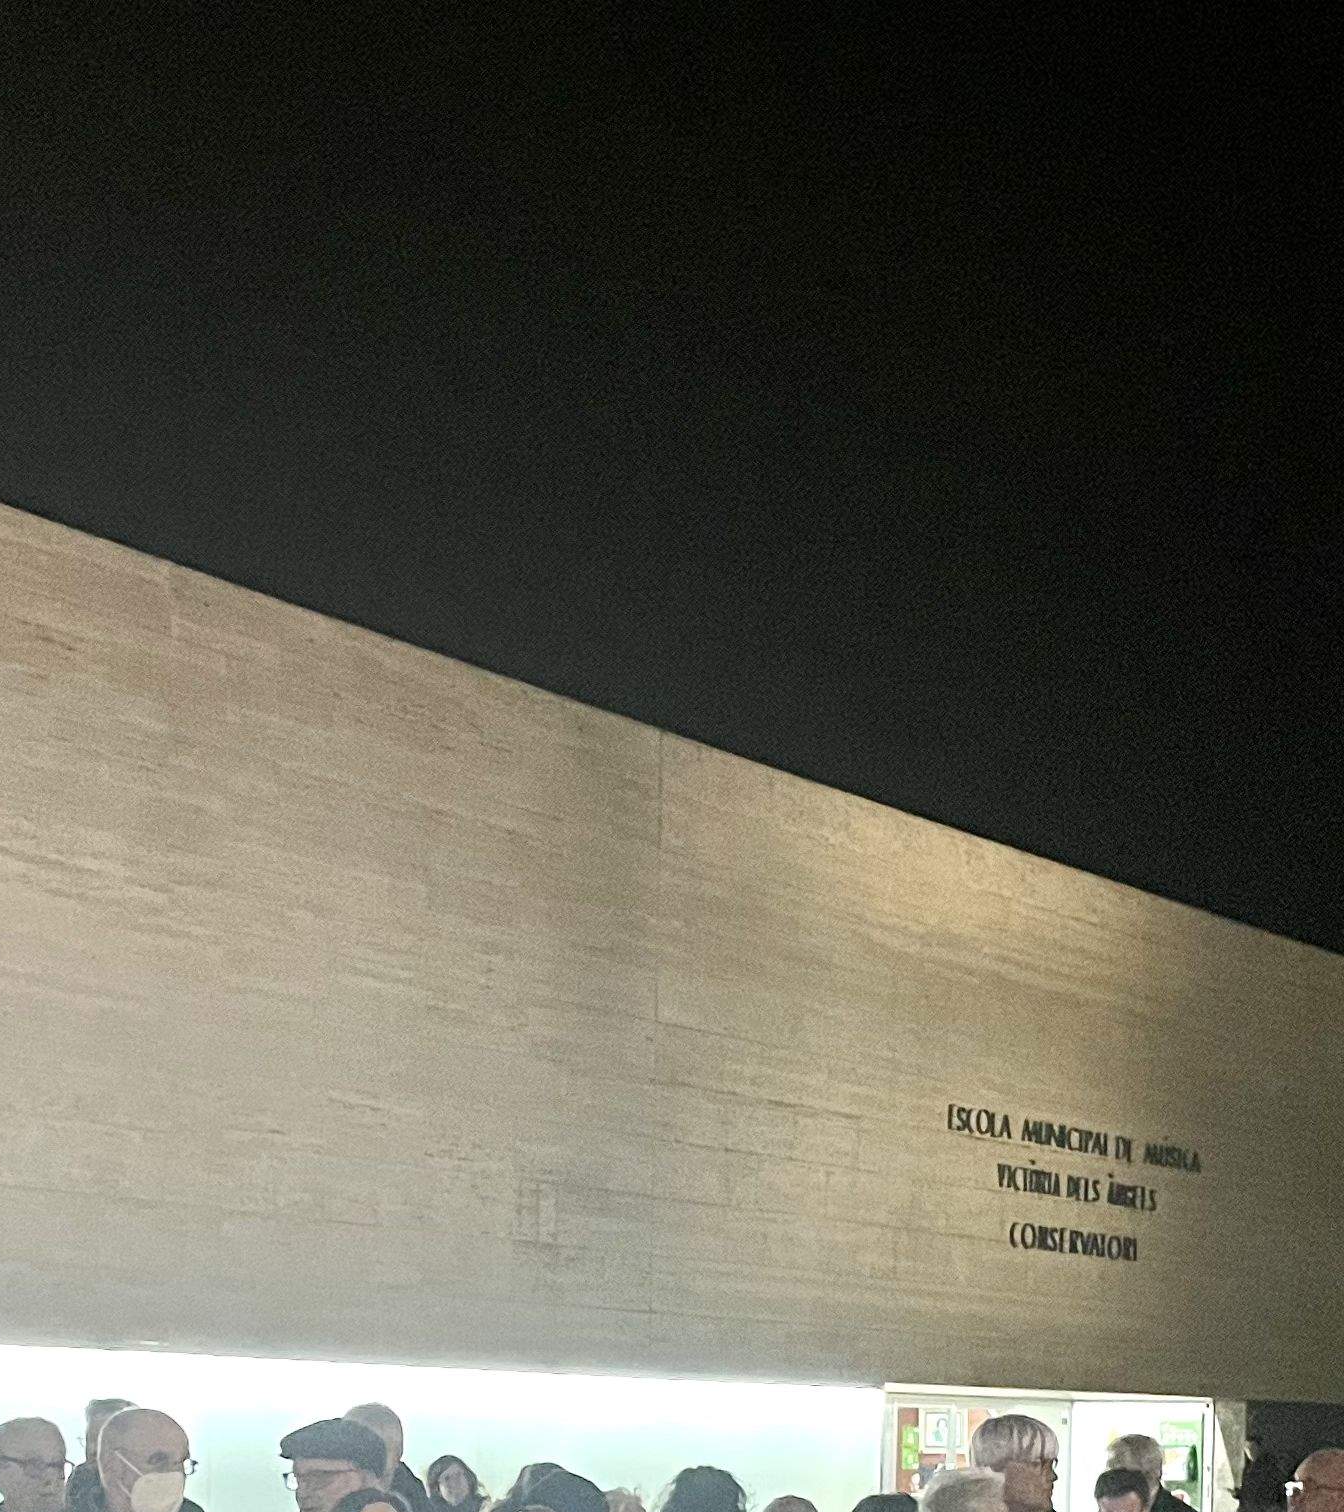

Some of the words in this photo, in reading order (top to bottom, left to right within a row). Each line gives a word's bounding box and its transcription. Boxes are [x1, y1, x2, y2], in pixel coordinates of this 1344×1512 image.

[947, 1104, 1012, 1139] ESCOLA
[1022, 1117, 1108, 1157] MUNICIPAL
[1066, 1174, 1101, 1203] DELS
[1009, 1222, 1138, 1261] CONSERVATORI
